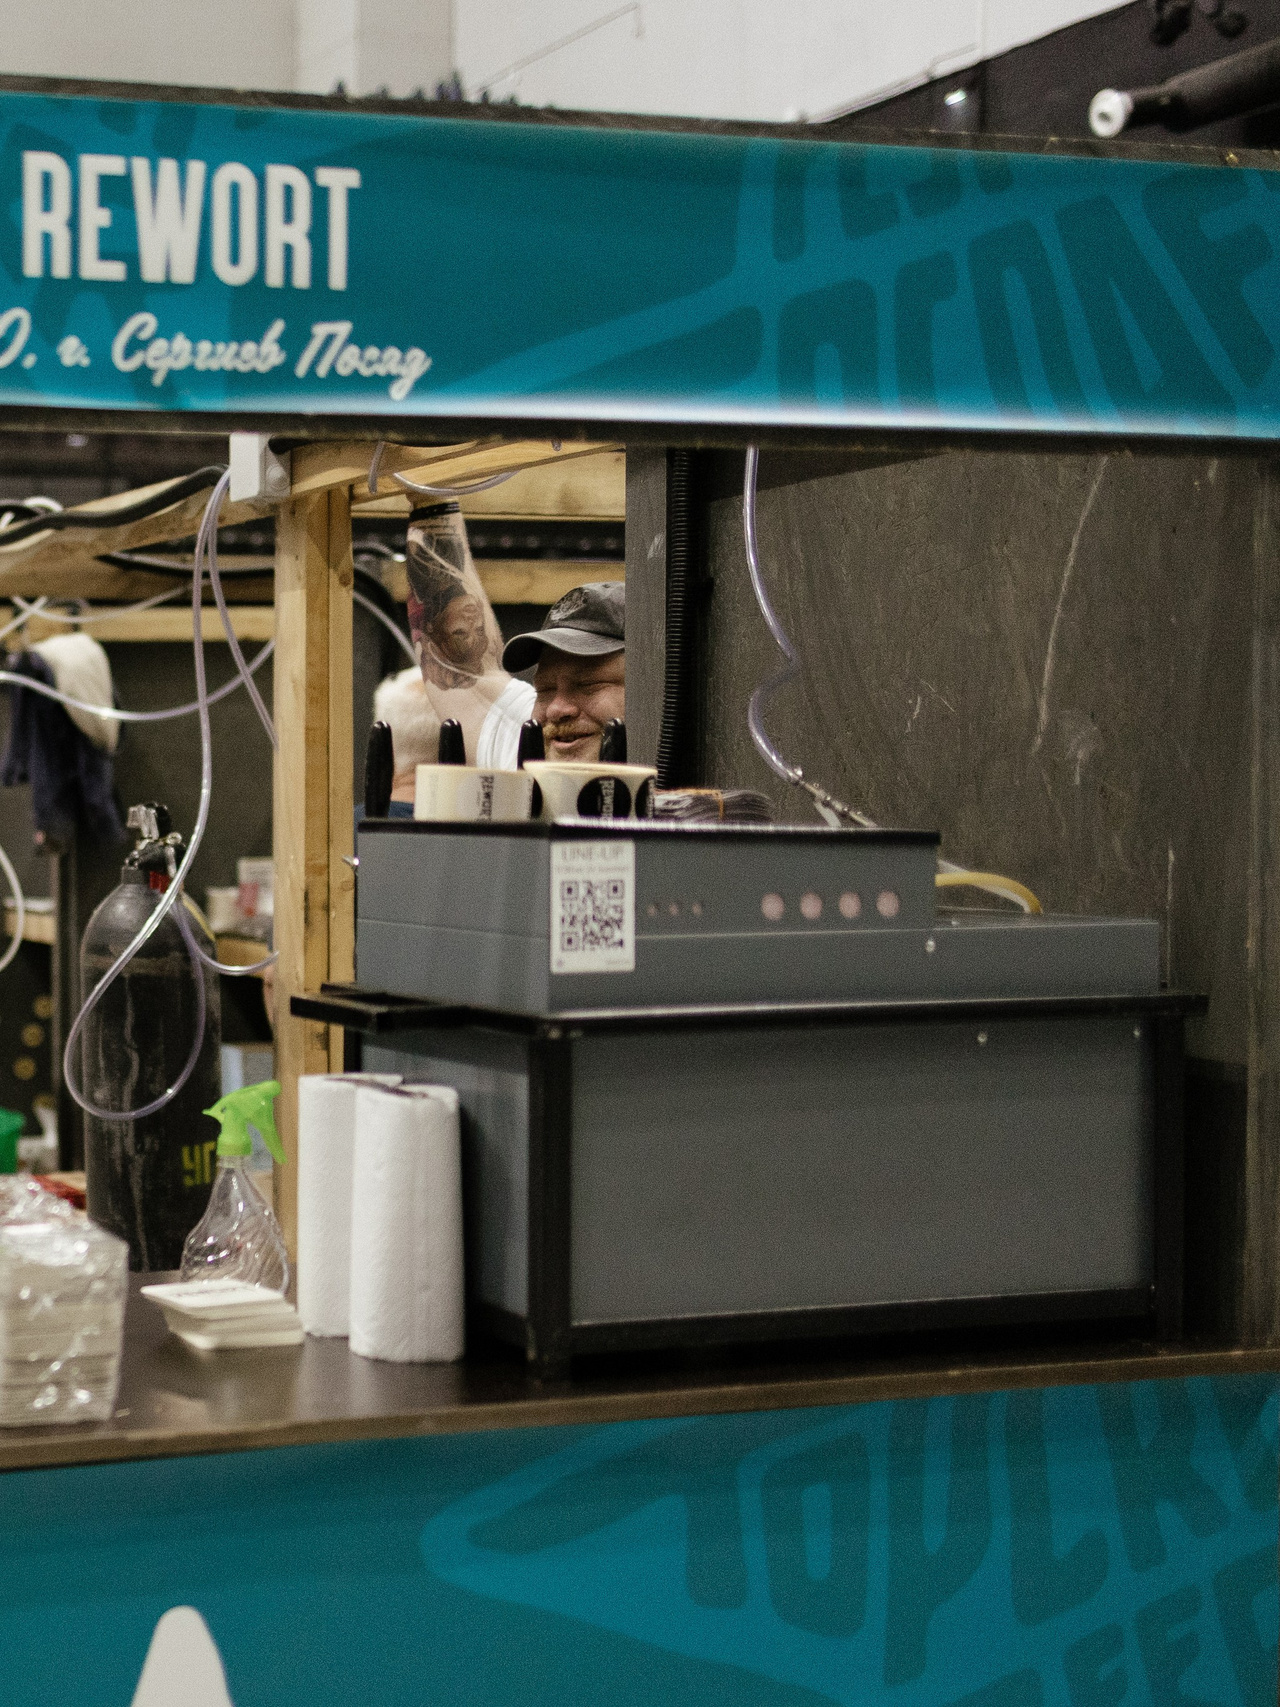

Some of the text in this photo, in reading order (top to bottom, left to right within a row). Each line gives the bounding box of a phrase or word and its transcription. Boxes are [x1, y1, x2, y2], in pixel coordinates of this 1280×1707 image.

[22, 150, 361, 291] REWORT
[112, 312, 286, 387] Сергиев
[295, 320, 432, 400] Посад
